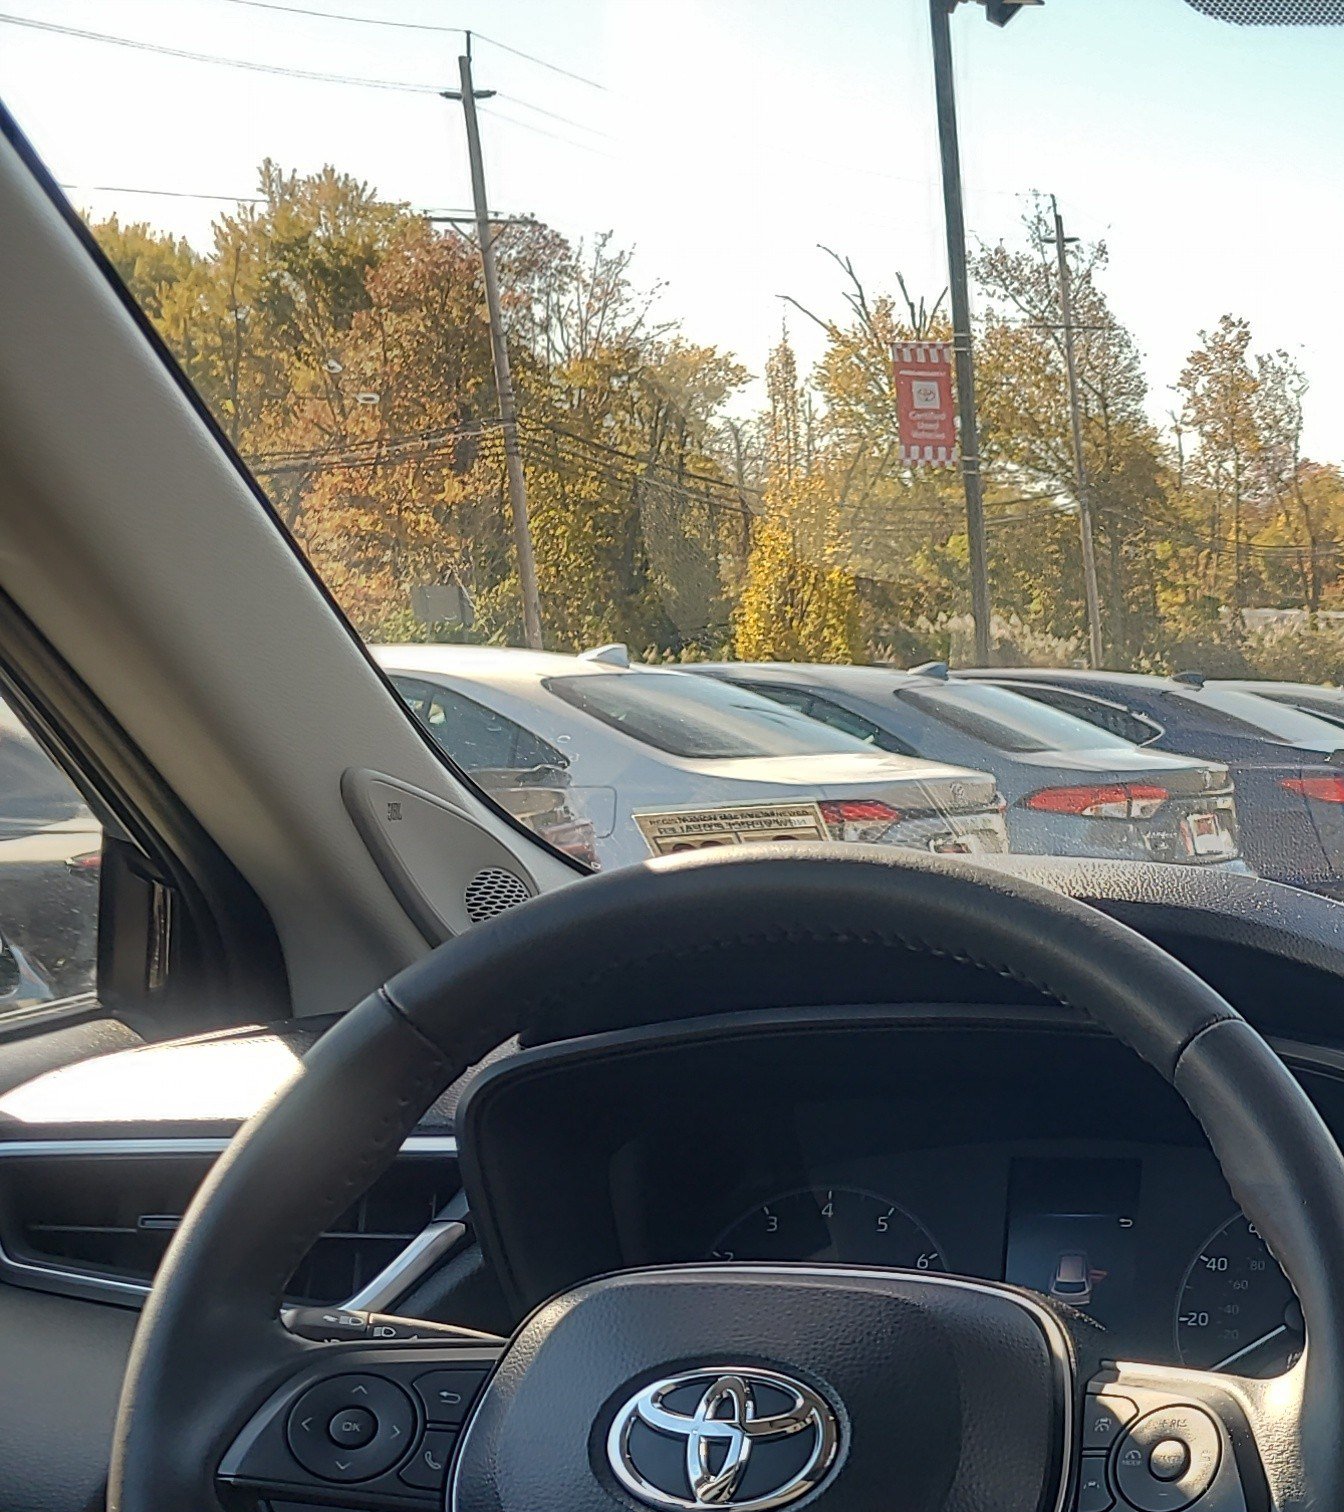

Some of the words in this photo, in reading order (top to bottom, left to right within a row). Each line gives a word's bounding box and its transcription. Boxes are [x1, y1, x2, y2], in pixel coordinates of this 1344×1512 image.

[821, 1203, 834, 1218] 4
[766, 1216, 778, 1232] 3
[876, 1217, 888, 1232] 5
[917, 1254, 929, 1269] 6
[1206, 1257, 1228, 1271] 40
[1233, 1280, 1249, 1290] 60
[1187, 1312, 1209, 1326] 20
[343, 1422, 360, 1431] OK
